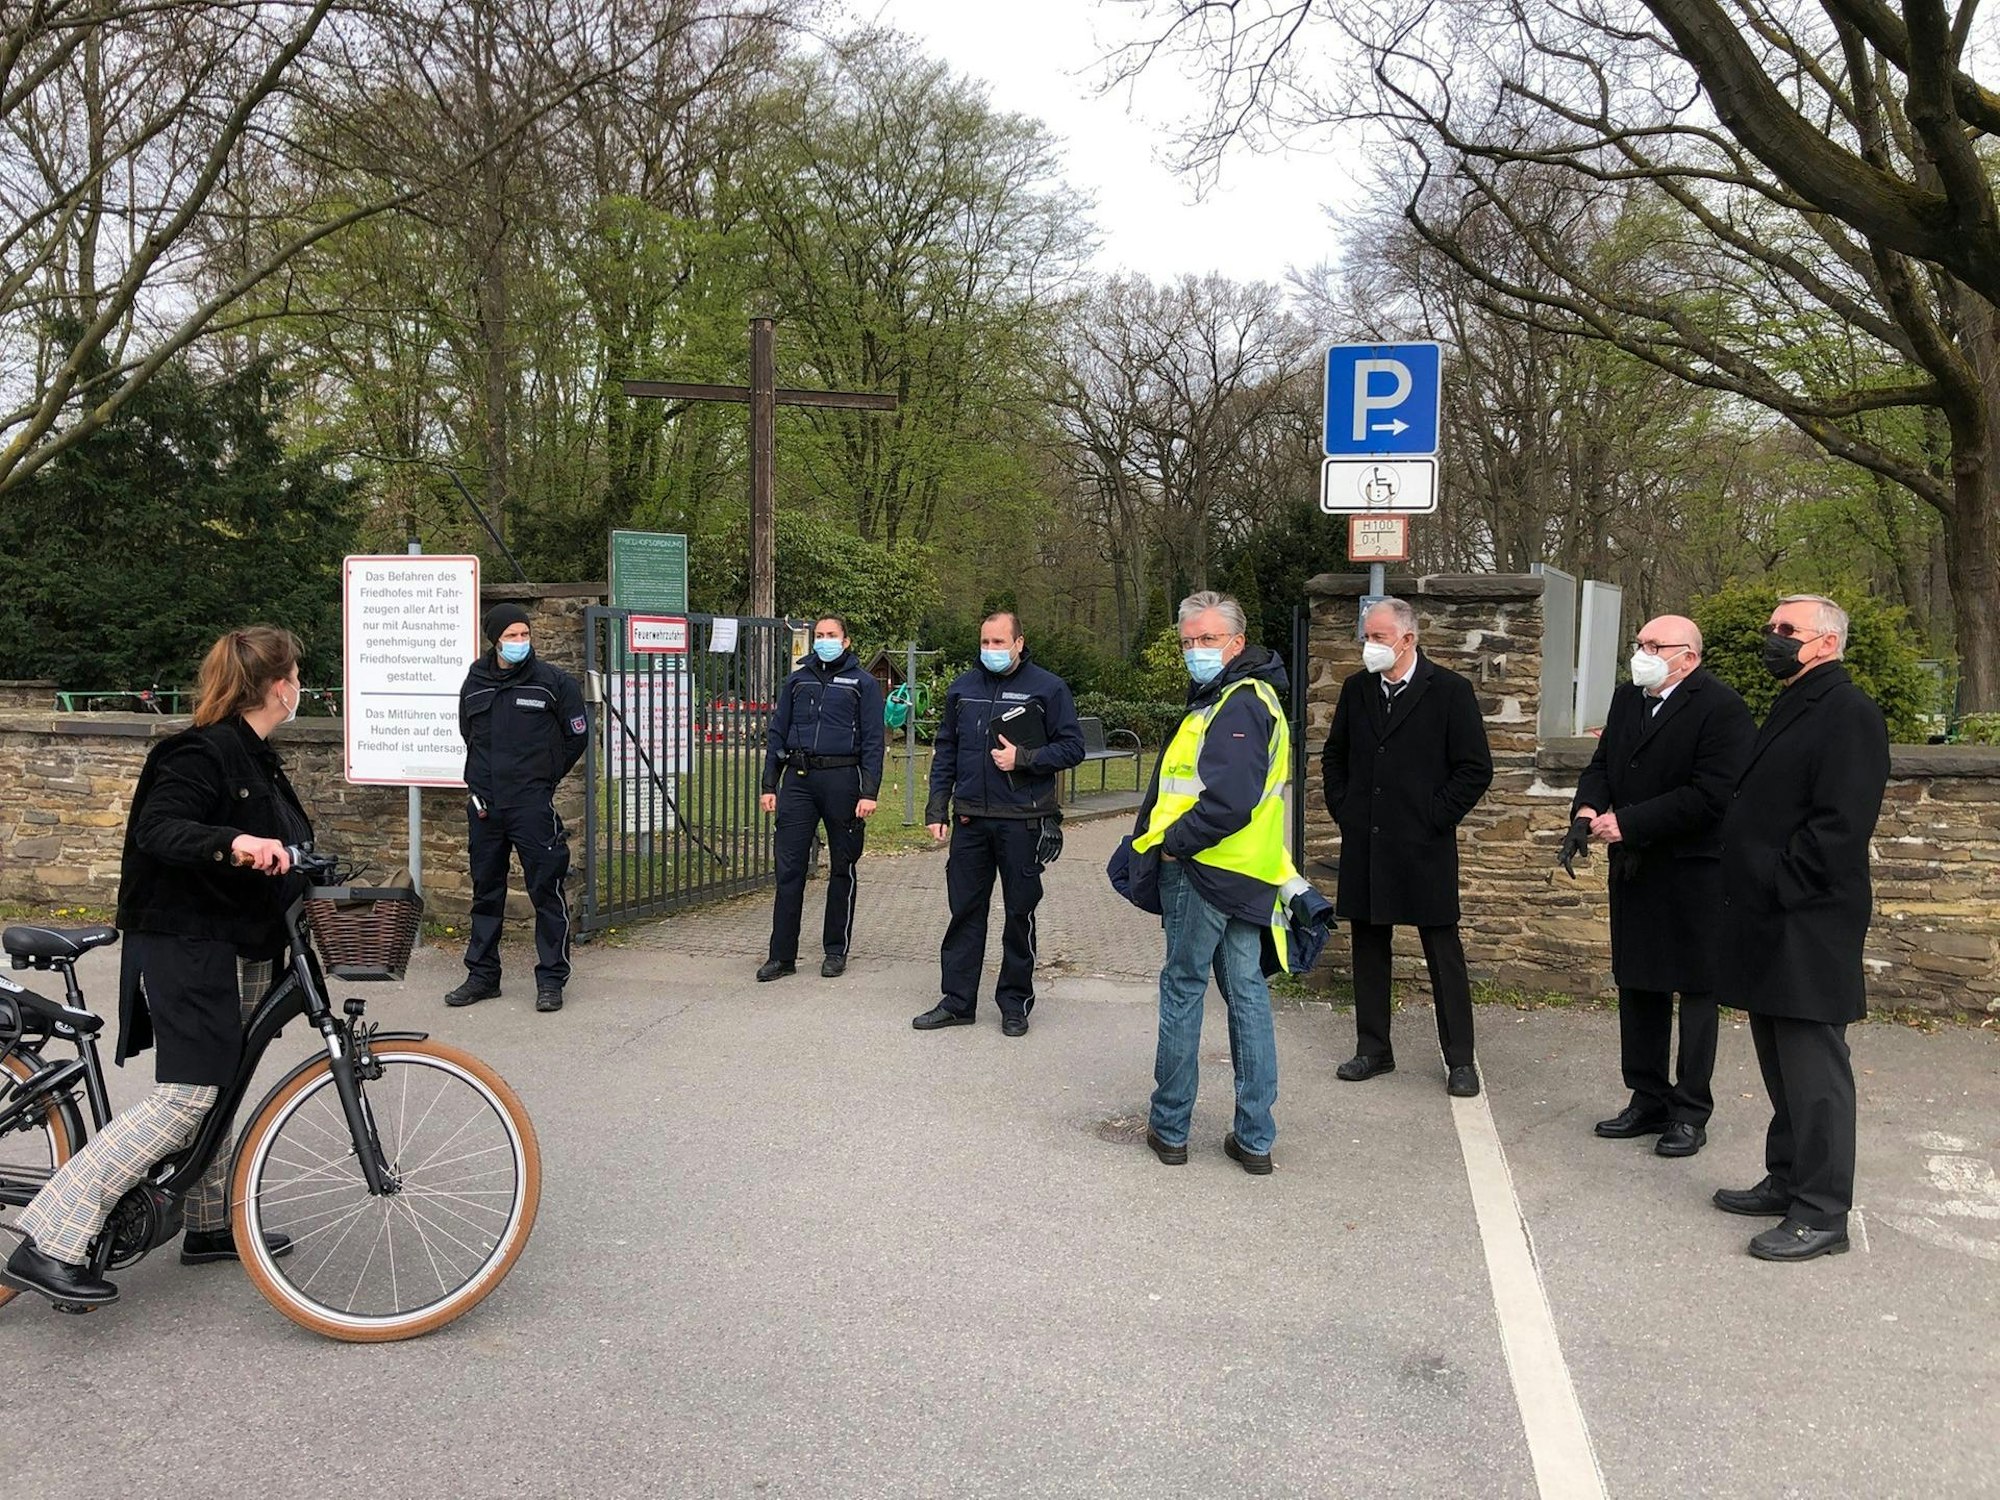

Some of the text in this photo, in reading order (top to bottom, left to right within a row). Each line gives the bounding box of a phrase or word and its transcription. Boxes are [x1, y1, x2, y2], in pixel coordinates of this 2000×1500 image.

[1353, 359, 1413, 441] P
[365, 571, 457, 582] Das Befahren des
[360, 587, 463, 599] Friedhofes mit Fahr-
[363, 603, 460, 616] zeugen aller Art ist
[362, 620, 460, 631] nur mit Ausnahme-
[365, 636, 457, 650] genehmigung der
[359, 652, 463, 667] Friedhofsverwaltung
[386, 671, 436, 683] gestattet.
[365, 708, 458, 721] Das Mitführen von
[370, 724, 453, 737] Hunden auf den
[357, 740, 399, 752] Friedhof
[401, 741, 415, 753] ist
